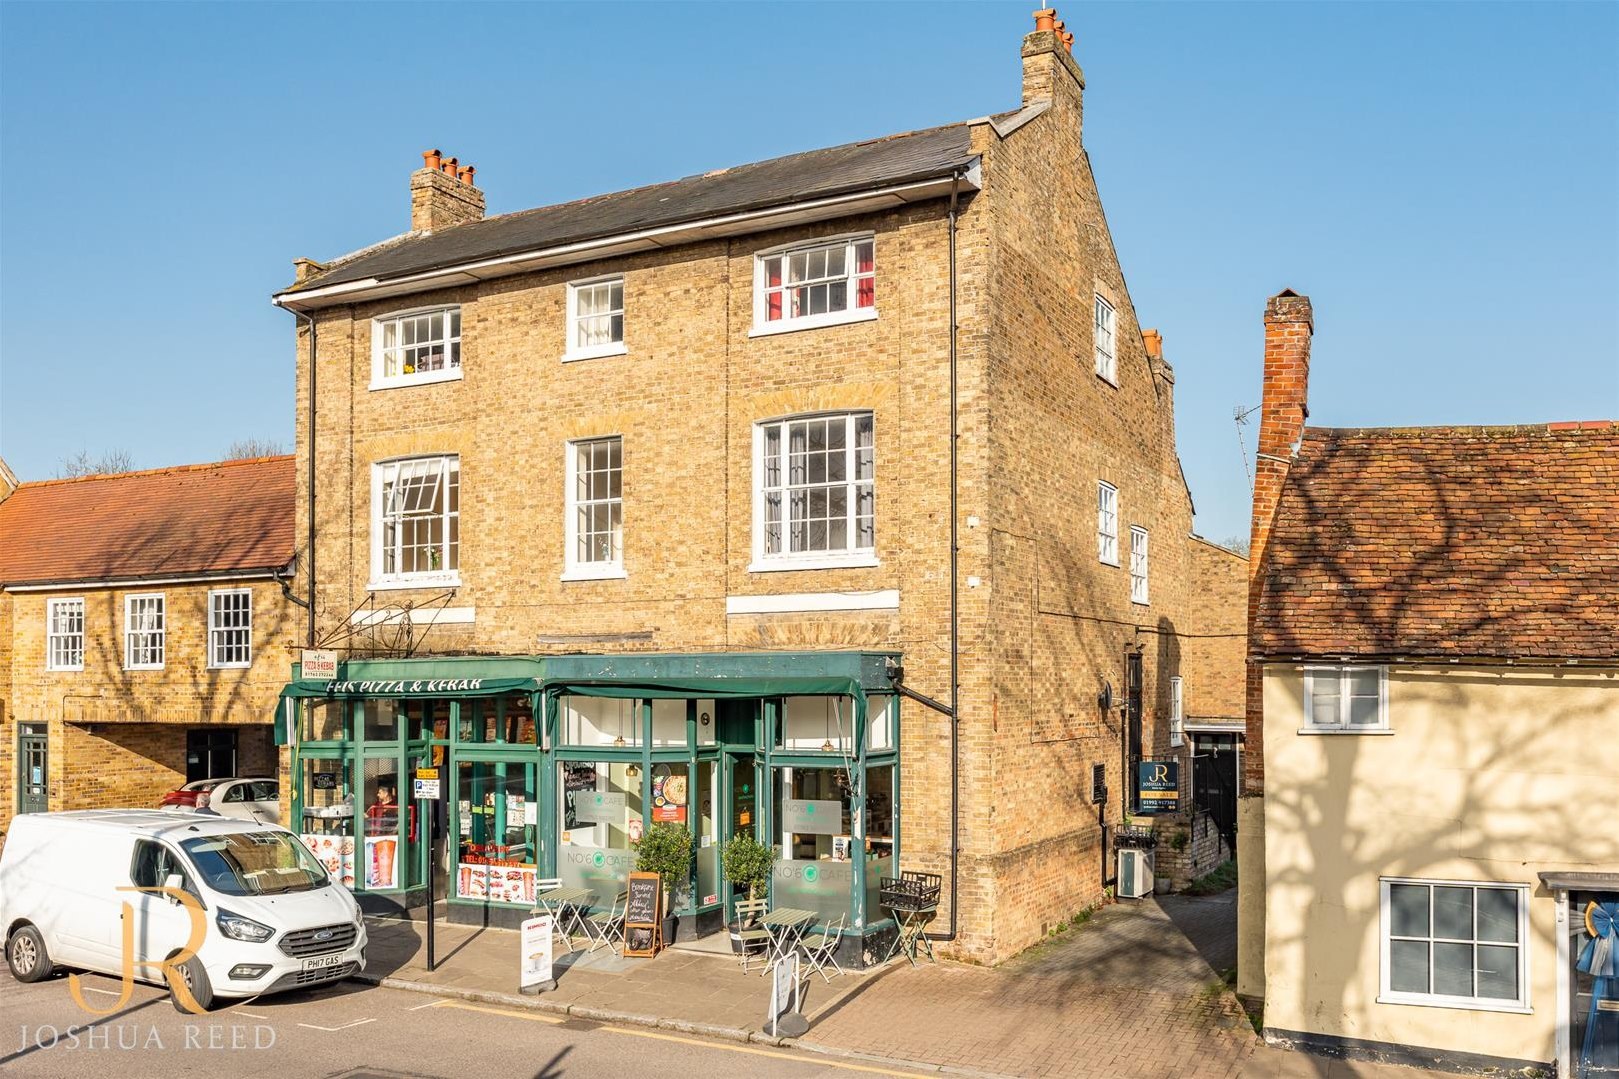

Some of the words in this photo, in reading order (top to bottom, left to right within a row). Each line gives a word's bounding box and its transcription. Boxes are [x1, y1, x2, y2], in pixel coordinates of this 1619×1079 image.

[304, 660, 316, 670] PIZZA
[321, 661, 335, 671] KEBAB
[410, 680, 422, 692] &
[1149, 764, 1168, 783] JR
[307, 959, 324, 969] PH17
[325, 956, 339, 966] GAS
